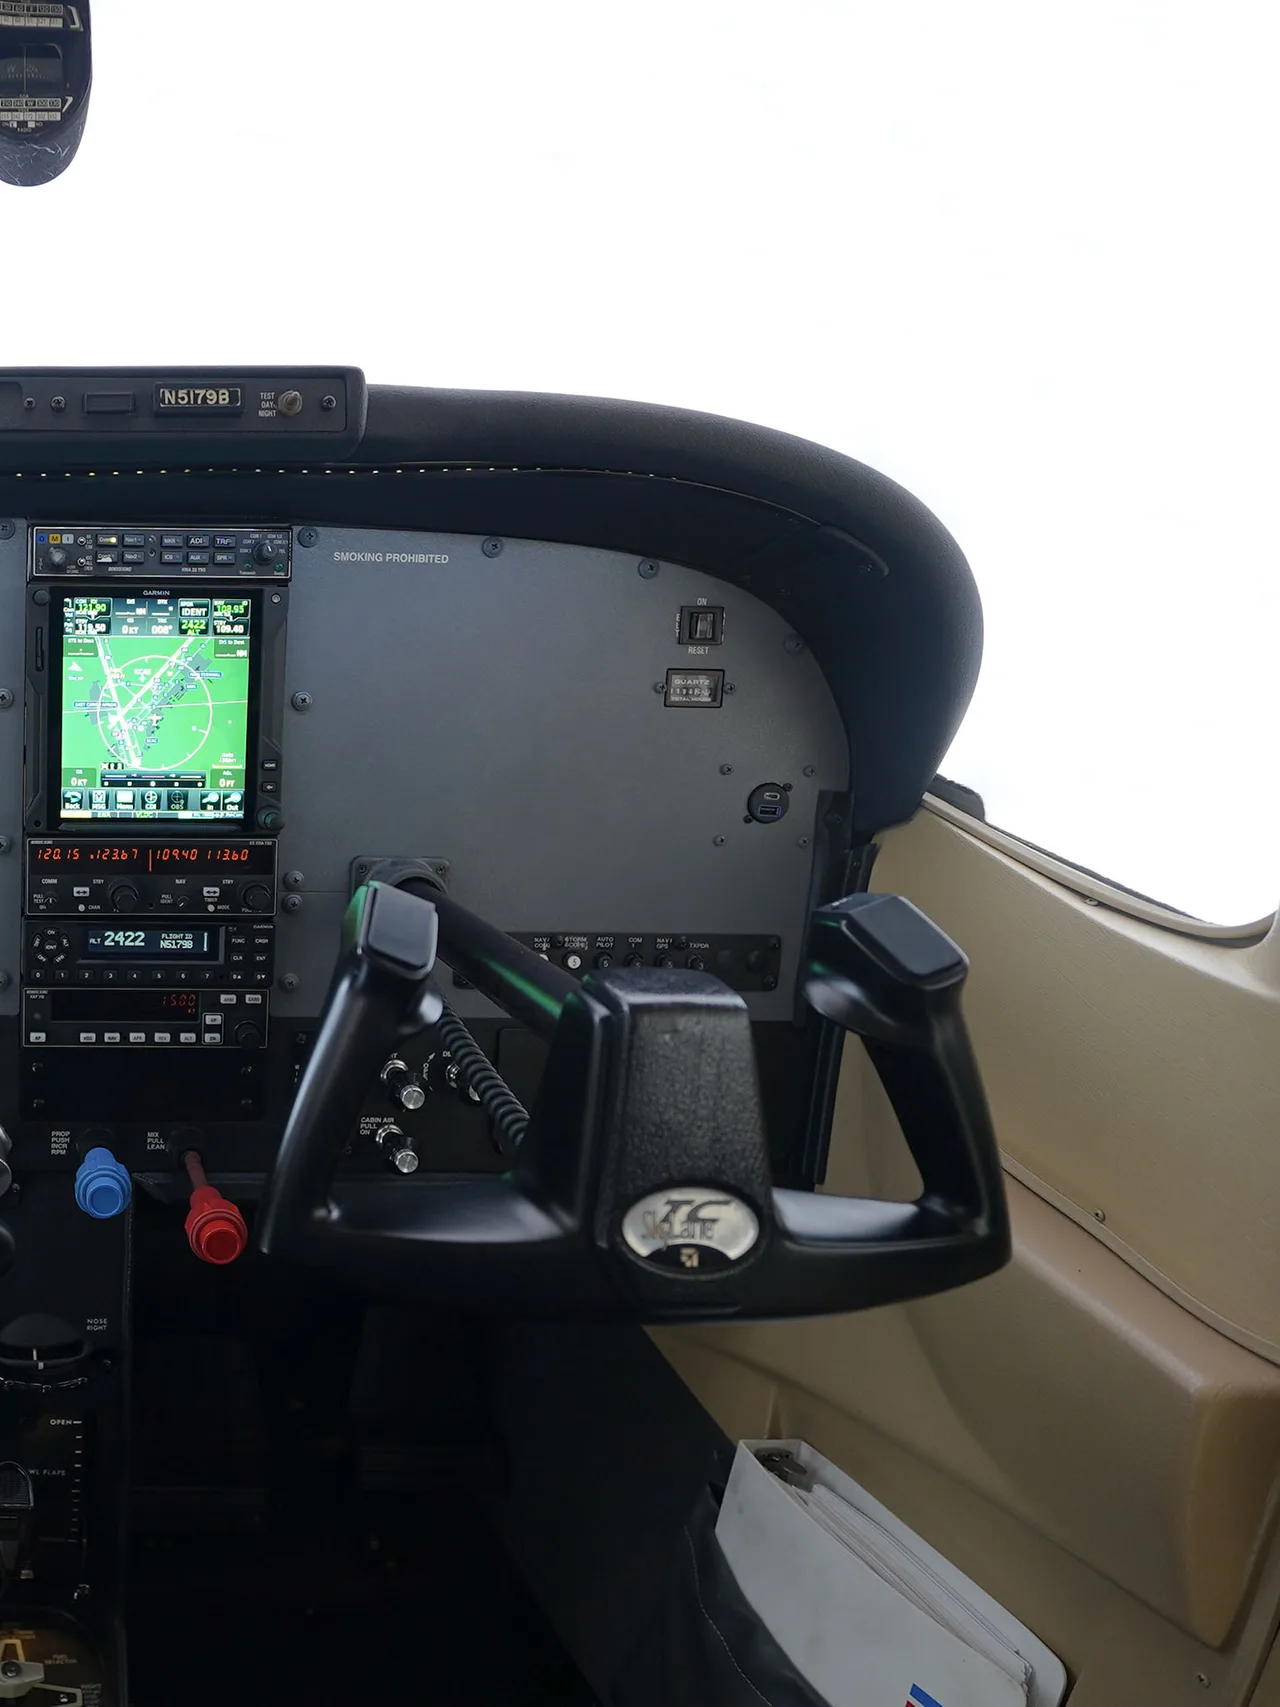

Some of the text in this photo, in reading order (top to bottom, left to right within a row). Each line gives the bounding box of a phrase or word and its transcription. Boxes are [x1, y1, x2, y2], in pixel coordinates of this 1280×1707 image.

[164, 390, 230, 405] N5179B
[334, 552, 449, 564] SMOKING PROHIBITED
[78, 604, 106, 612] 121.90
[182, 608, 207, 616] IDENT
[181, 620, 206, 629] 2422
[104, 932, 145, 947] 2422
